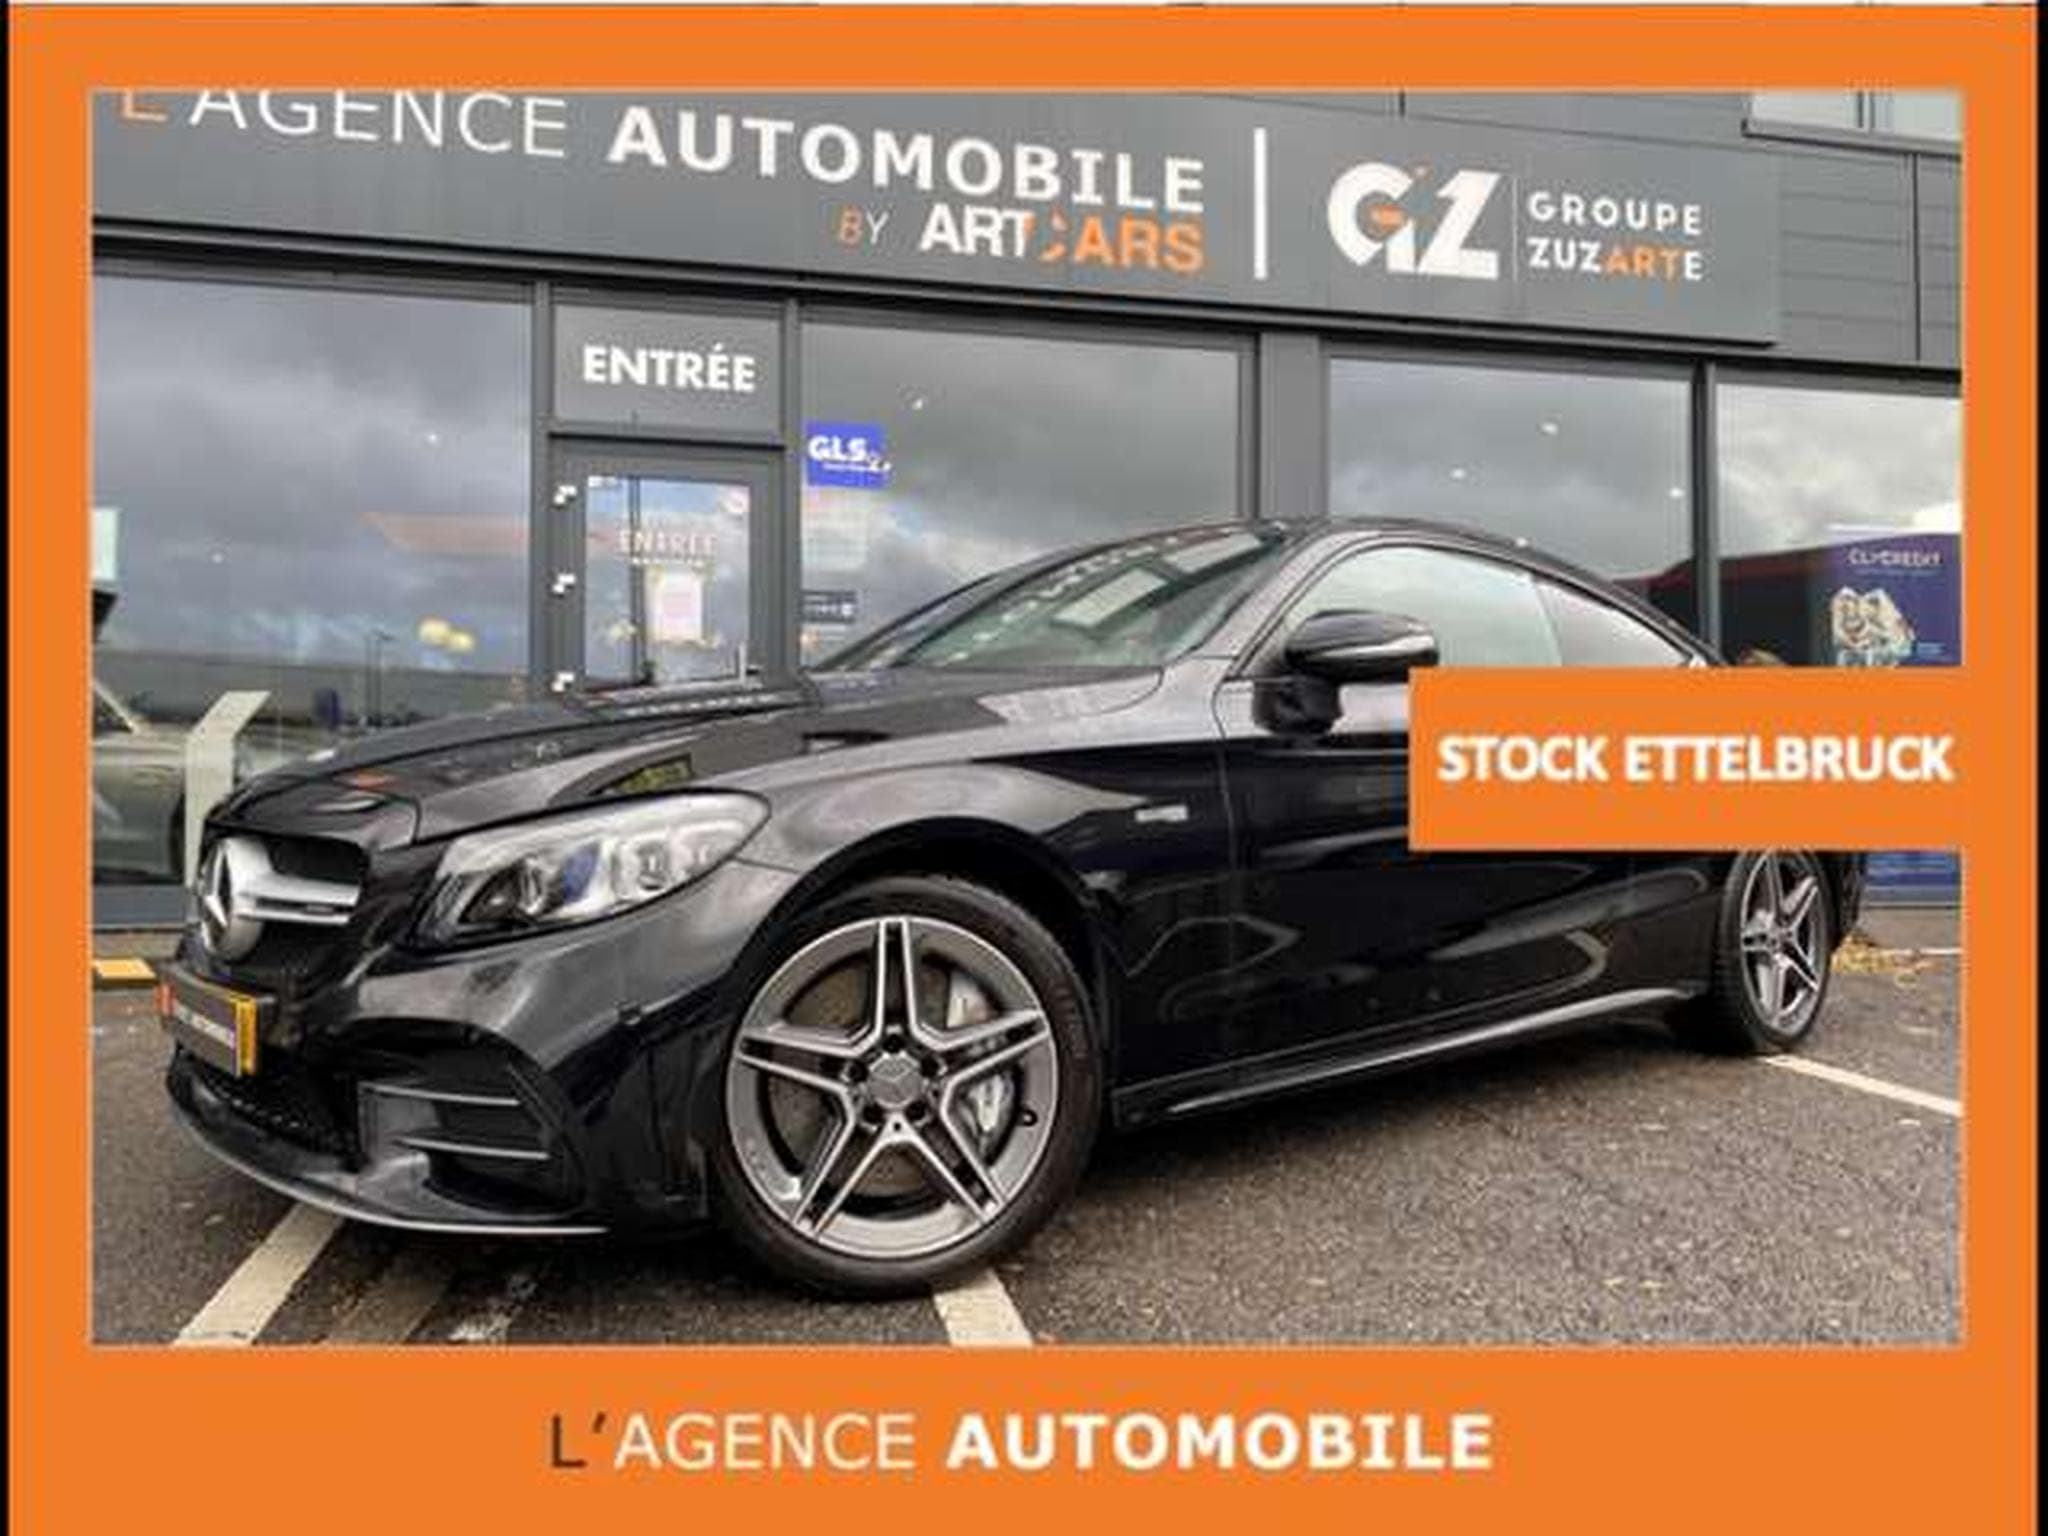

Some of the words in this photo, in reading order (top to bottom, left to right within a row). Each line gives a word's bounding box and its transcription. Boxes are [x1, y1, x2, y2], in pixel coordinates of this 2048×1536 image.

[121, 90, 566, 158] LAGENCE
[607, 105, 1205, 213] AUTOMOBILE
[839, 207, 888, 246] BY
[1527, 191, 1703, 236] GROUPE
[1526, 236, 1704, 281] ZUZARTE
[583, 343, 757, 393] ENTRÉE
[808, 435, 866, 461] GLS
